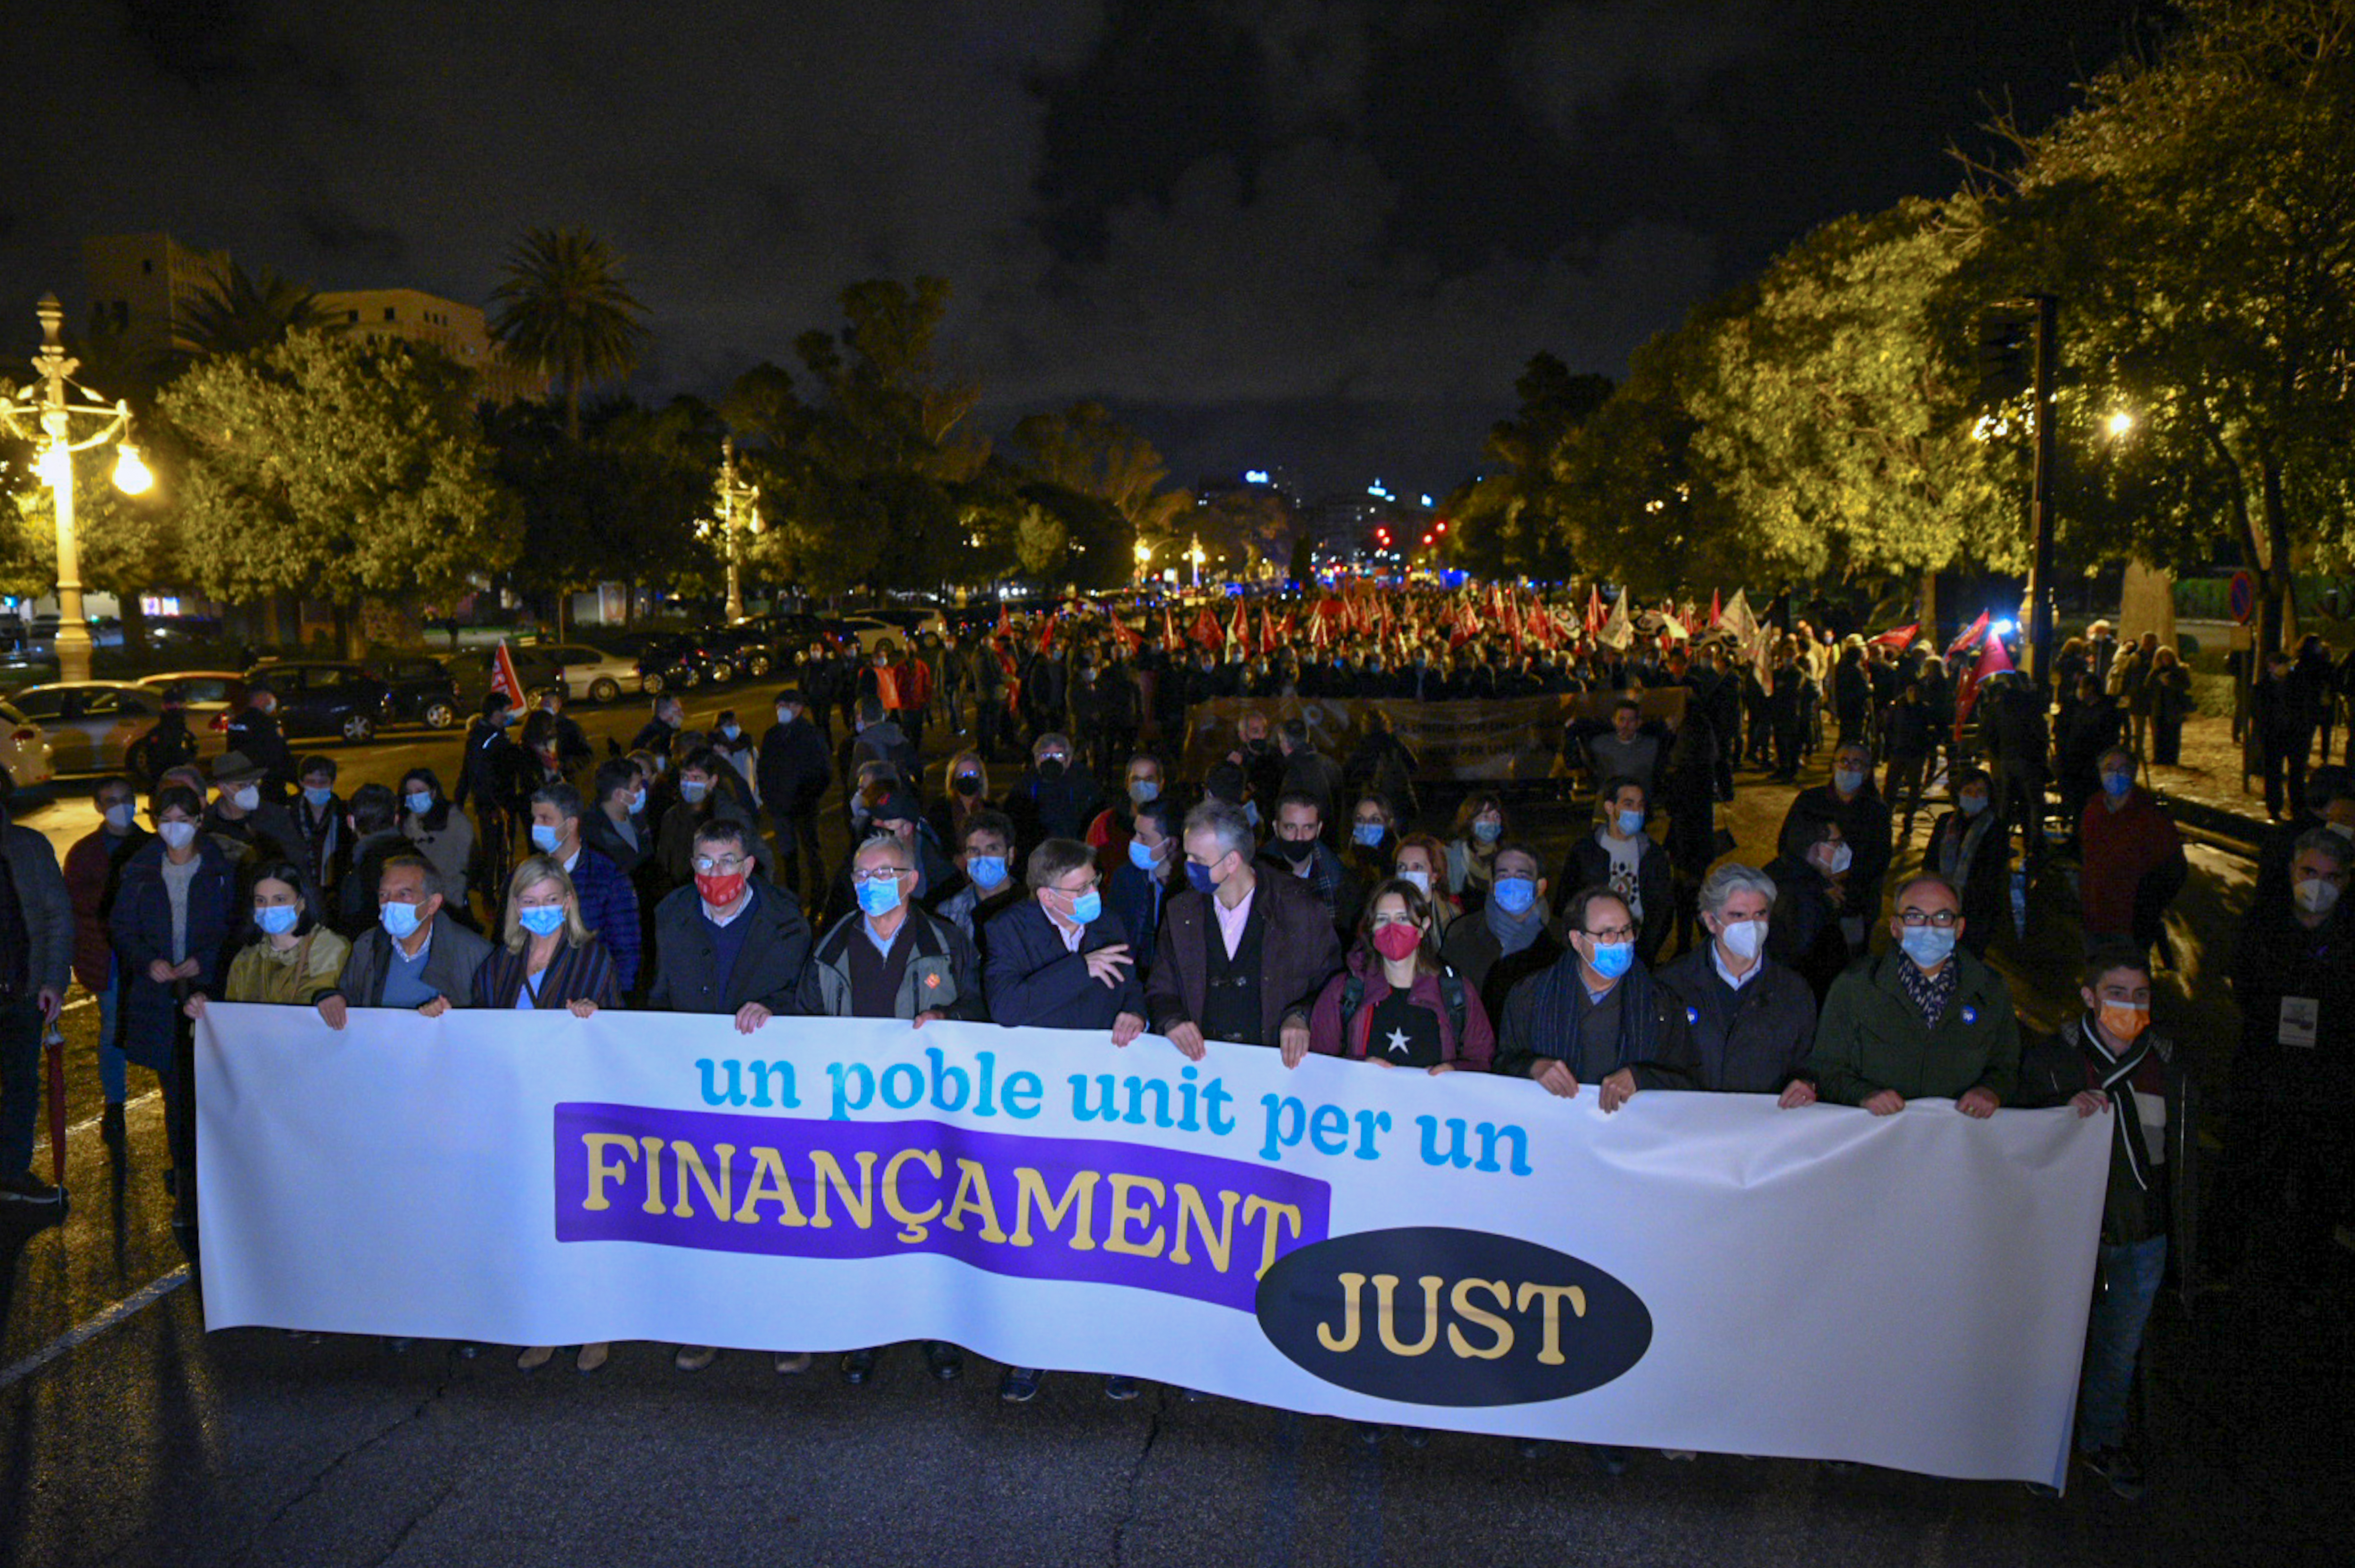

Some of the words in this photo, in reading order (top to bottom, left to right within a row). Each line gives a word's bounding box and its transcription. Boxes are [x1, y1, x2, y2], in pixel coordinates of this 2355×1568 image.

[695, 1058, 802, 1109] un
[825, 1047, 1044, 1121] poble
[1068, 1066, 1236, 1136] unit
[1259, 1093, 1392, 1162] per
[1416, 1115, 1534, 1177] un
[582, 1133, 1301, 1282] FINANÇAMENT
[1317, 1272, 1586, 1366] JUST
